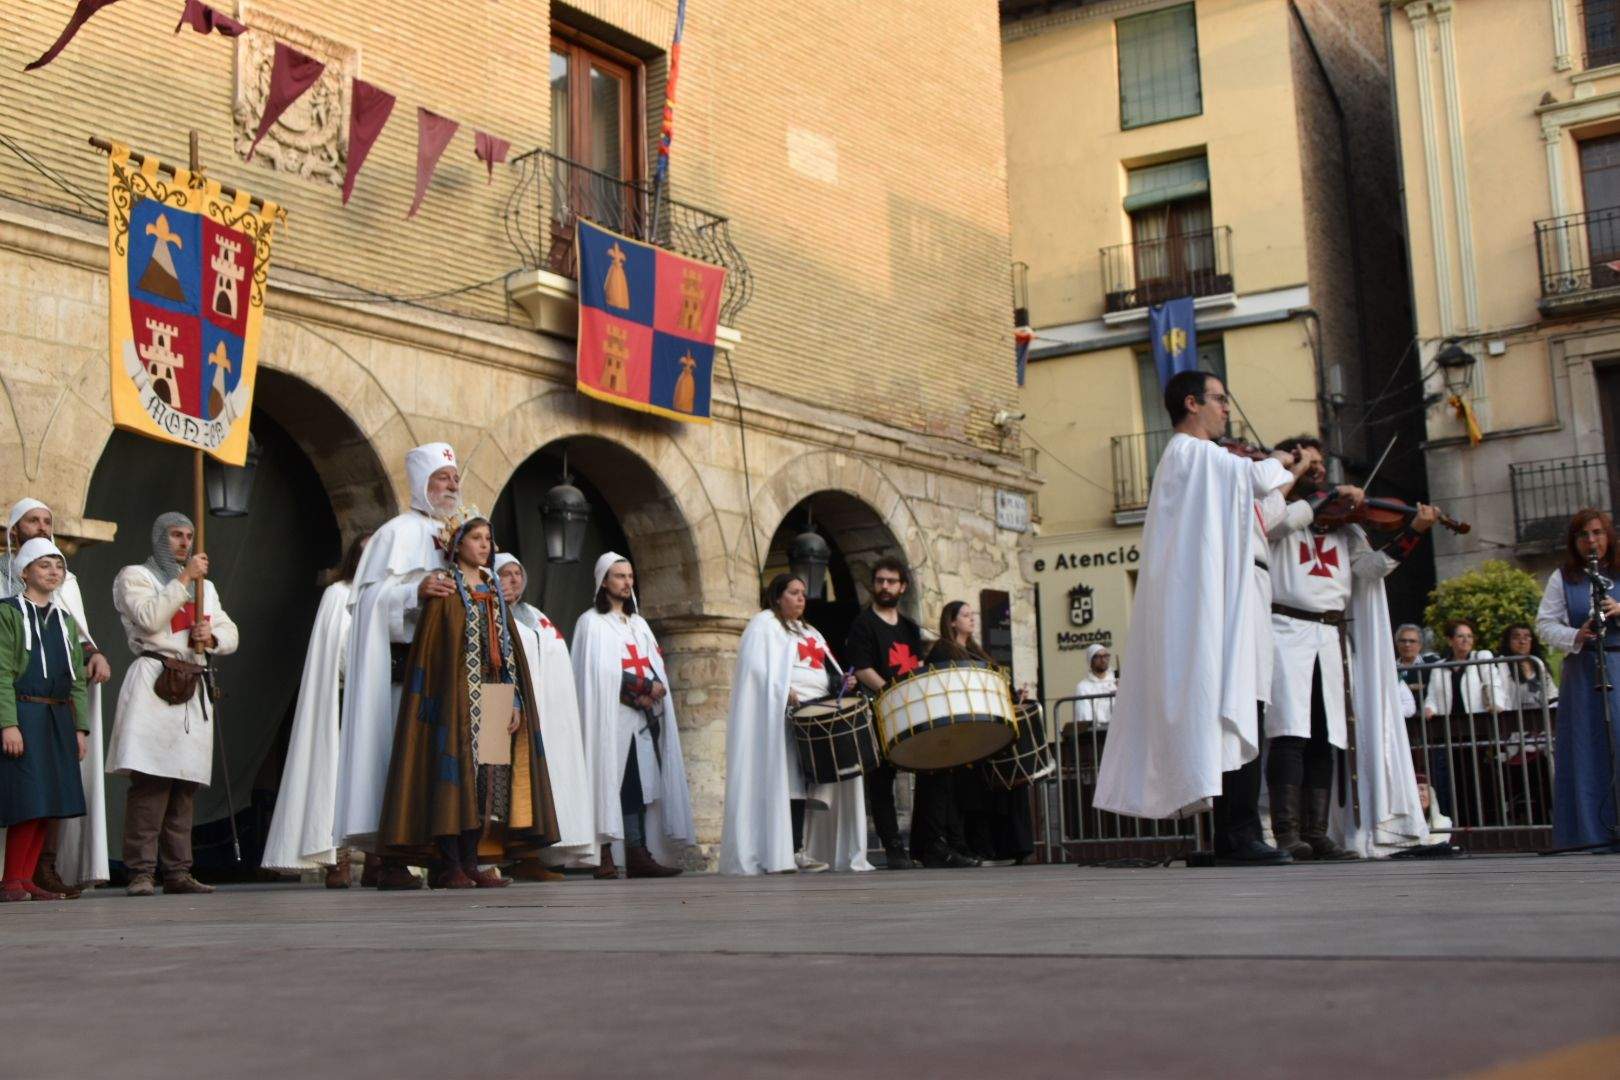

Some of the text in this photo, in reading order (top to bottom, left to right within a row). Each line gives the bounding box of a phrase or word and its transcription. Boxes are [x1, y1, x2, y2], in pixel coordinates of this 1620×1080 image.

[1034, 545, 1140, 572] e Atenció
[1057, 628, 1112, 643] Monzón
